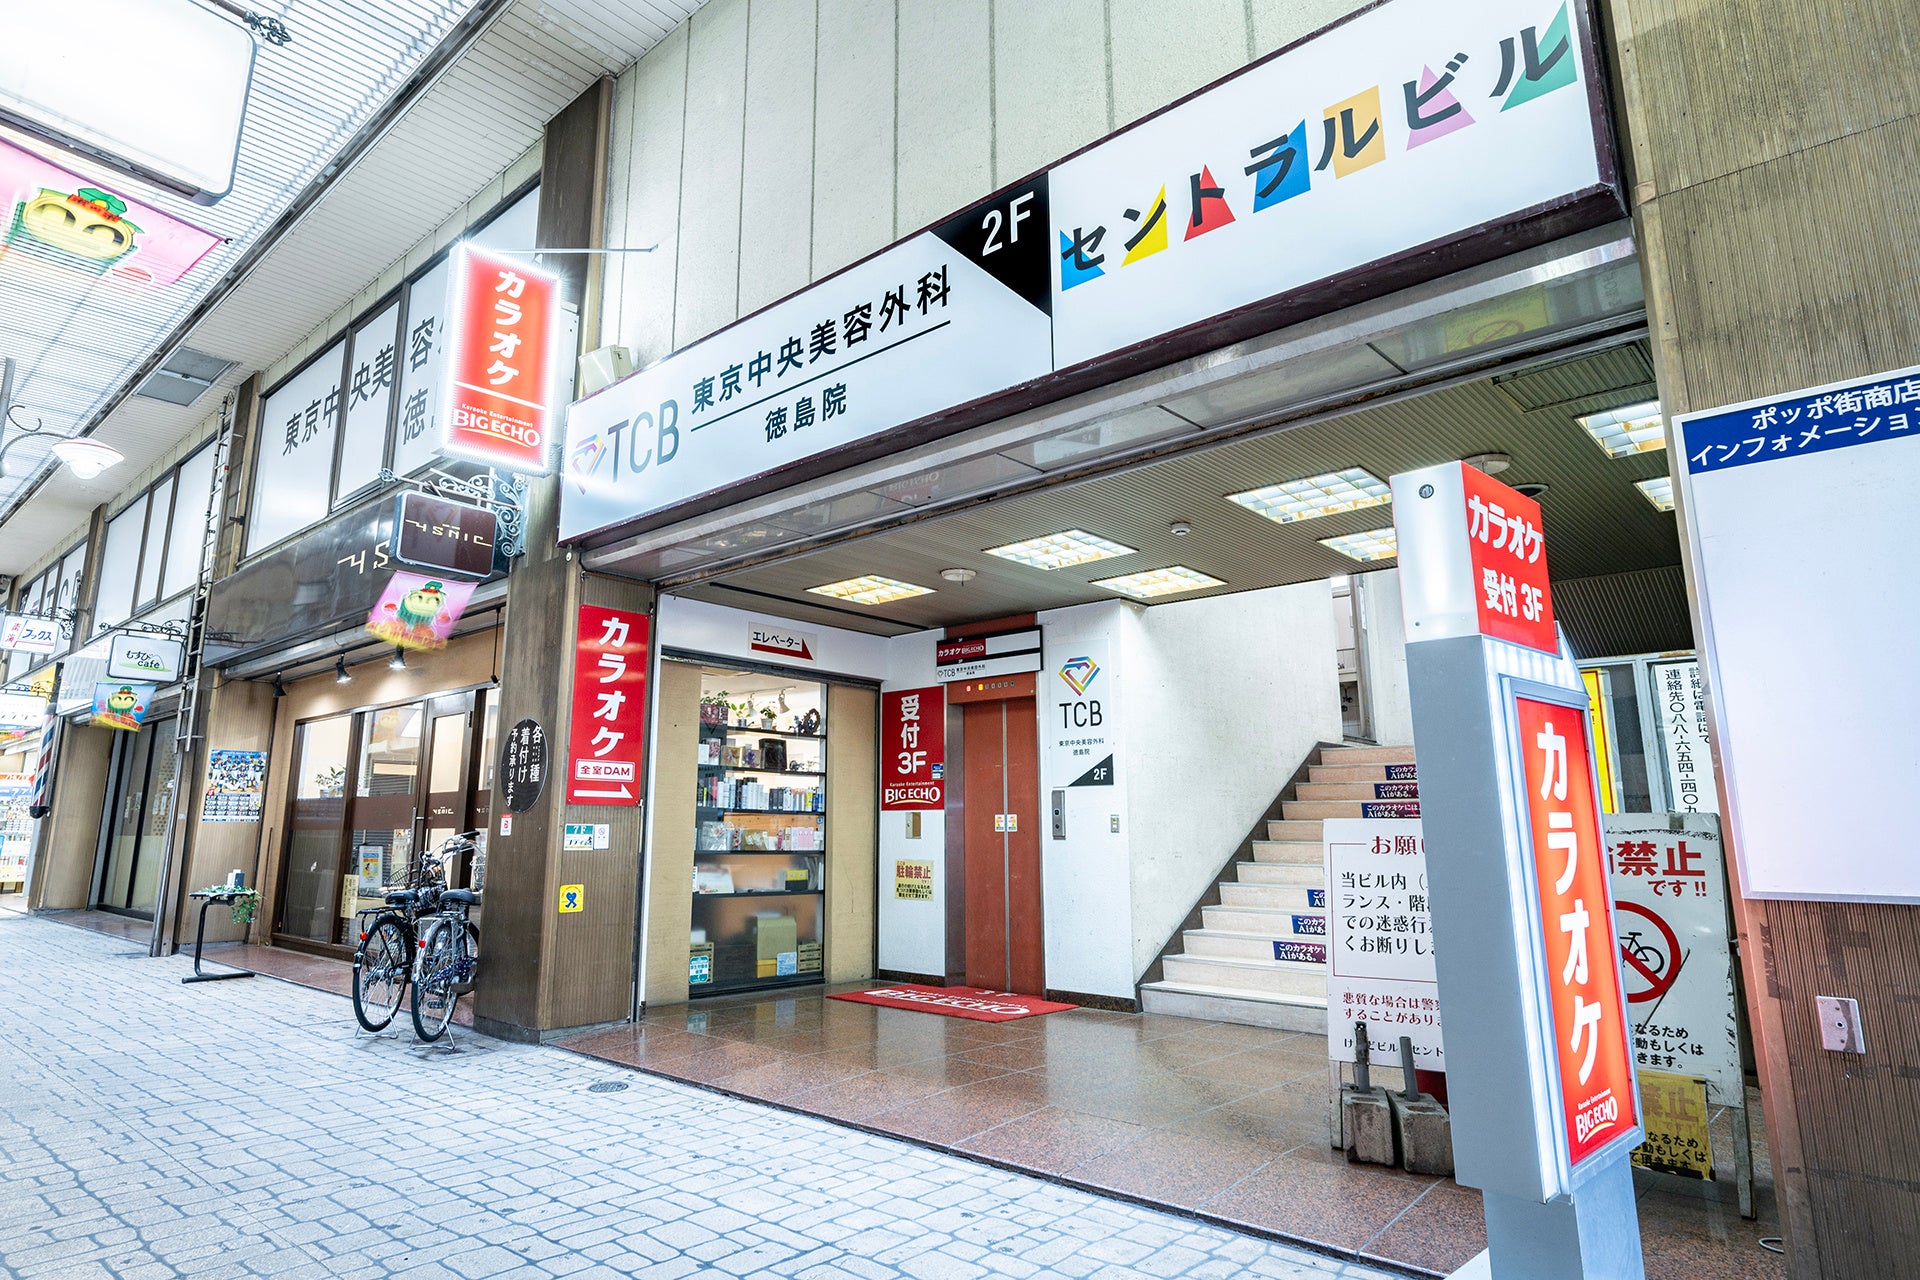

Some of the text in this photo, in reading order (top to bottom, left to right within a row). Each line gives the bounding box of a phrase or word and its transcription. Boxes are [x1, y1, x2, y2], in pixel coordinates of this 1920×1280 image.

[1061, 25, 1569, 271] セントラルビル
[982, 190, 1034, 256] 2F
[487, 270, 525, 386] カラオケ
[692, 263, 951, 415] 東京中央美容外科
[283, 316, 444, 456] 東京中央美容
[462, 403, 488, 416] Karaoke
[403, 387, 435, 445] 徳
[453, 408, 541, 447] BIG ECHO
[765, 382, 847, 443] 徳島院
[607, 399, 679, 483] TCB
[1468, 494, 1543, 564] カラオケ
[1482, 567, 1543, 622] 受付 3F
[753, 631, 800, 648] エレベーター
[938, 647, 962, 658] カラオケ
[591, 617, 630, 757] カラオケ
[944, 669, 955, 677] TCB
[1059, 700, 1102, 728] TCB
[518, 727, 531, 783] 着付け
[1059, 737, 1104, 747] 東京中央美容外科
[506, 728, 518, 807] 予約承ります
[1093, 768, 1107, 781] 2F
[885, 786, 941, 805] BIG ECHO
[1608, 840, 1705, 877] 禁止
[1342, 895, 1430, 912] ランス・階
[1342, 914, 1433, 934] での迷惑行
[1537, 721, 1602, 1086] カラオケ
[1299, 925, 1326, 933] Aiがあ
[1345, 935, 1435, 955] くお断りし
[1575, 1096, 1618, 1143] BIG ECHO
